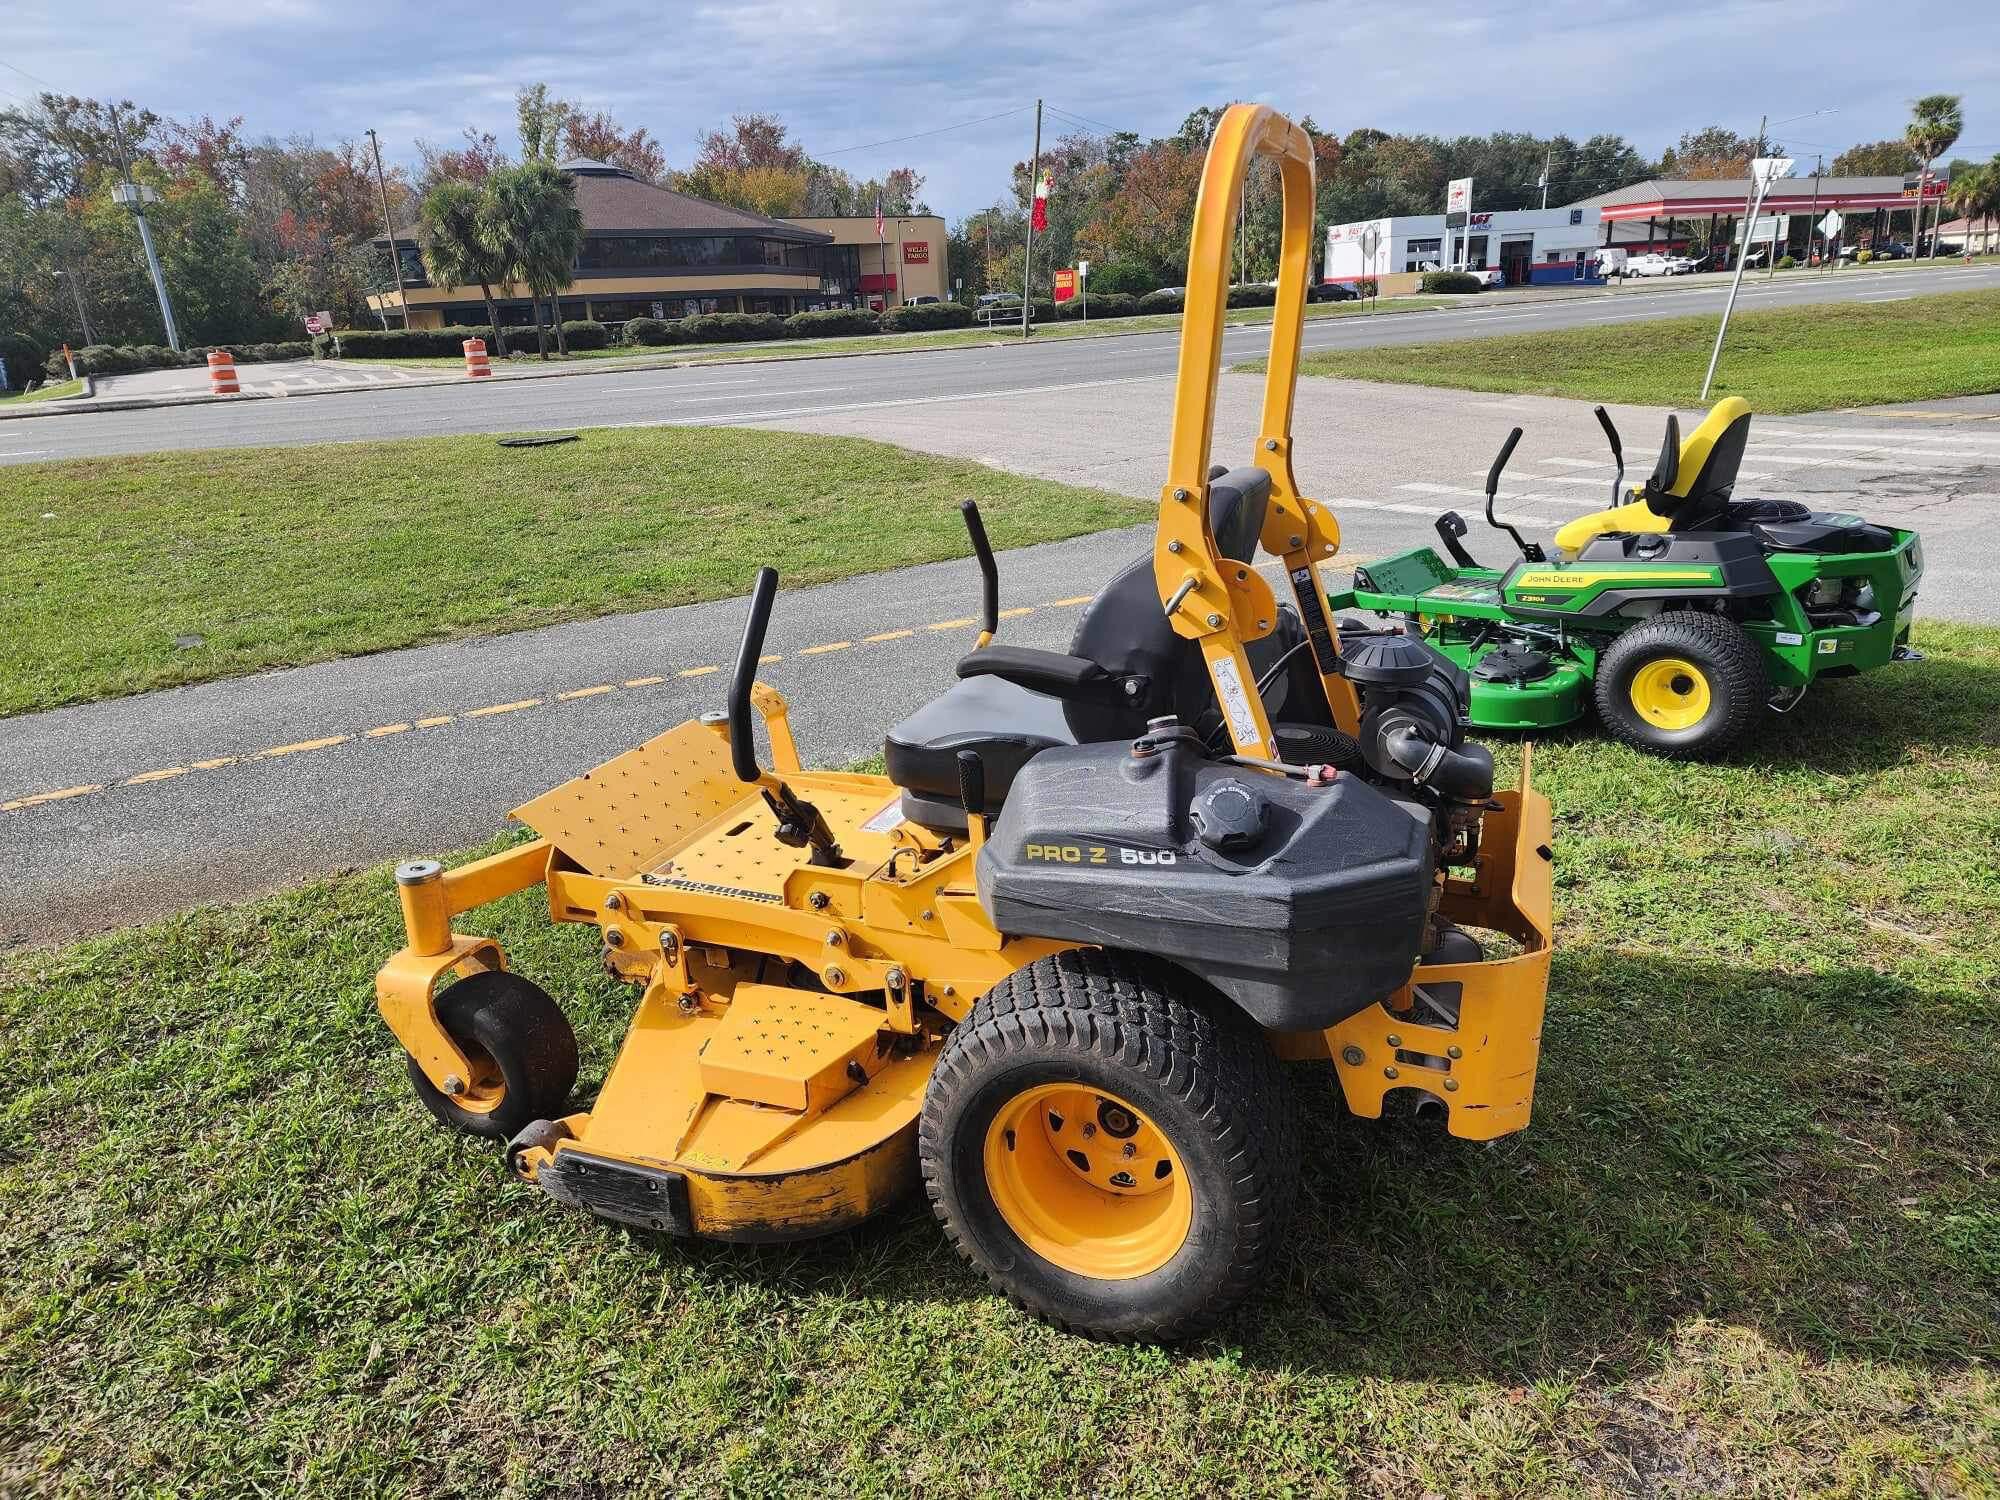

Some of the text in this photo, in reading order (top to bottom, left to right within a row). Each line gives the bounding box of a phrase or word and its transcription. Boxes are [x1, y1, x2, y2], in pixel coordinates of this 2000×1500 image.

[1527, 575, 1585, 583] JOHN DEERE
[1026, 844, 1177, 865] PRO Z 500
